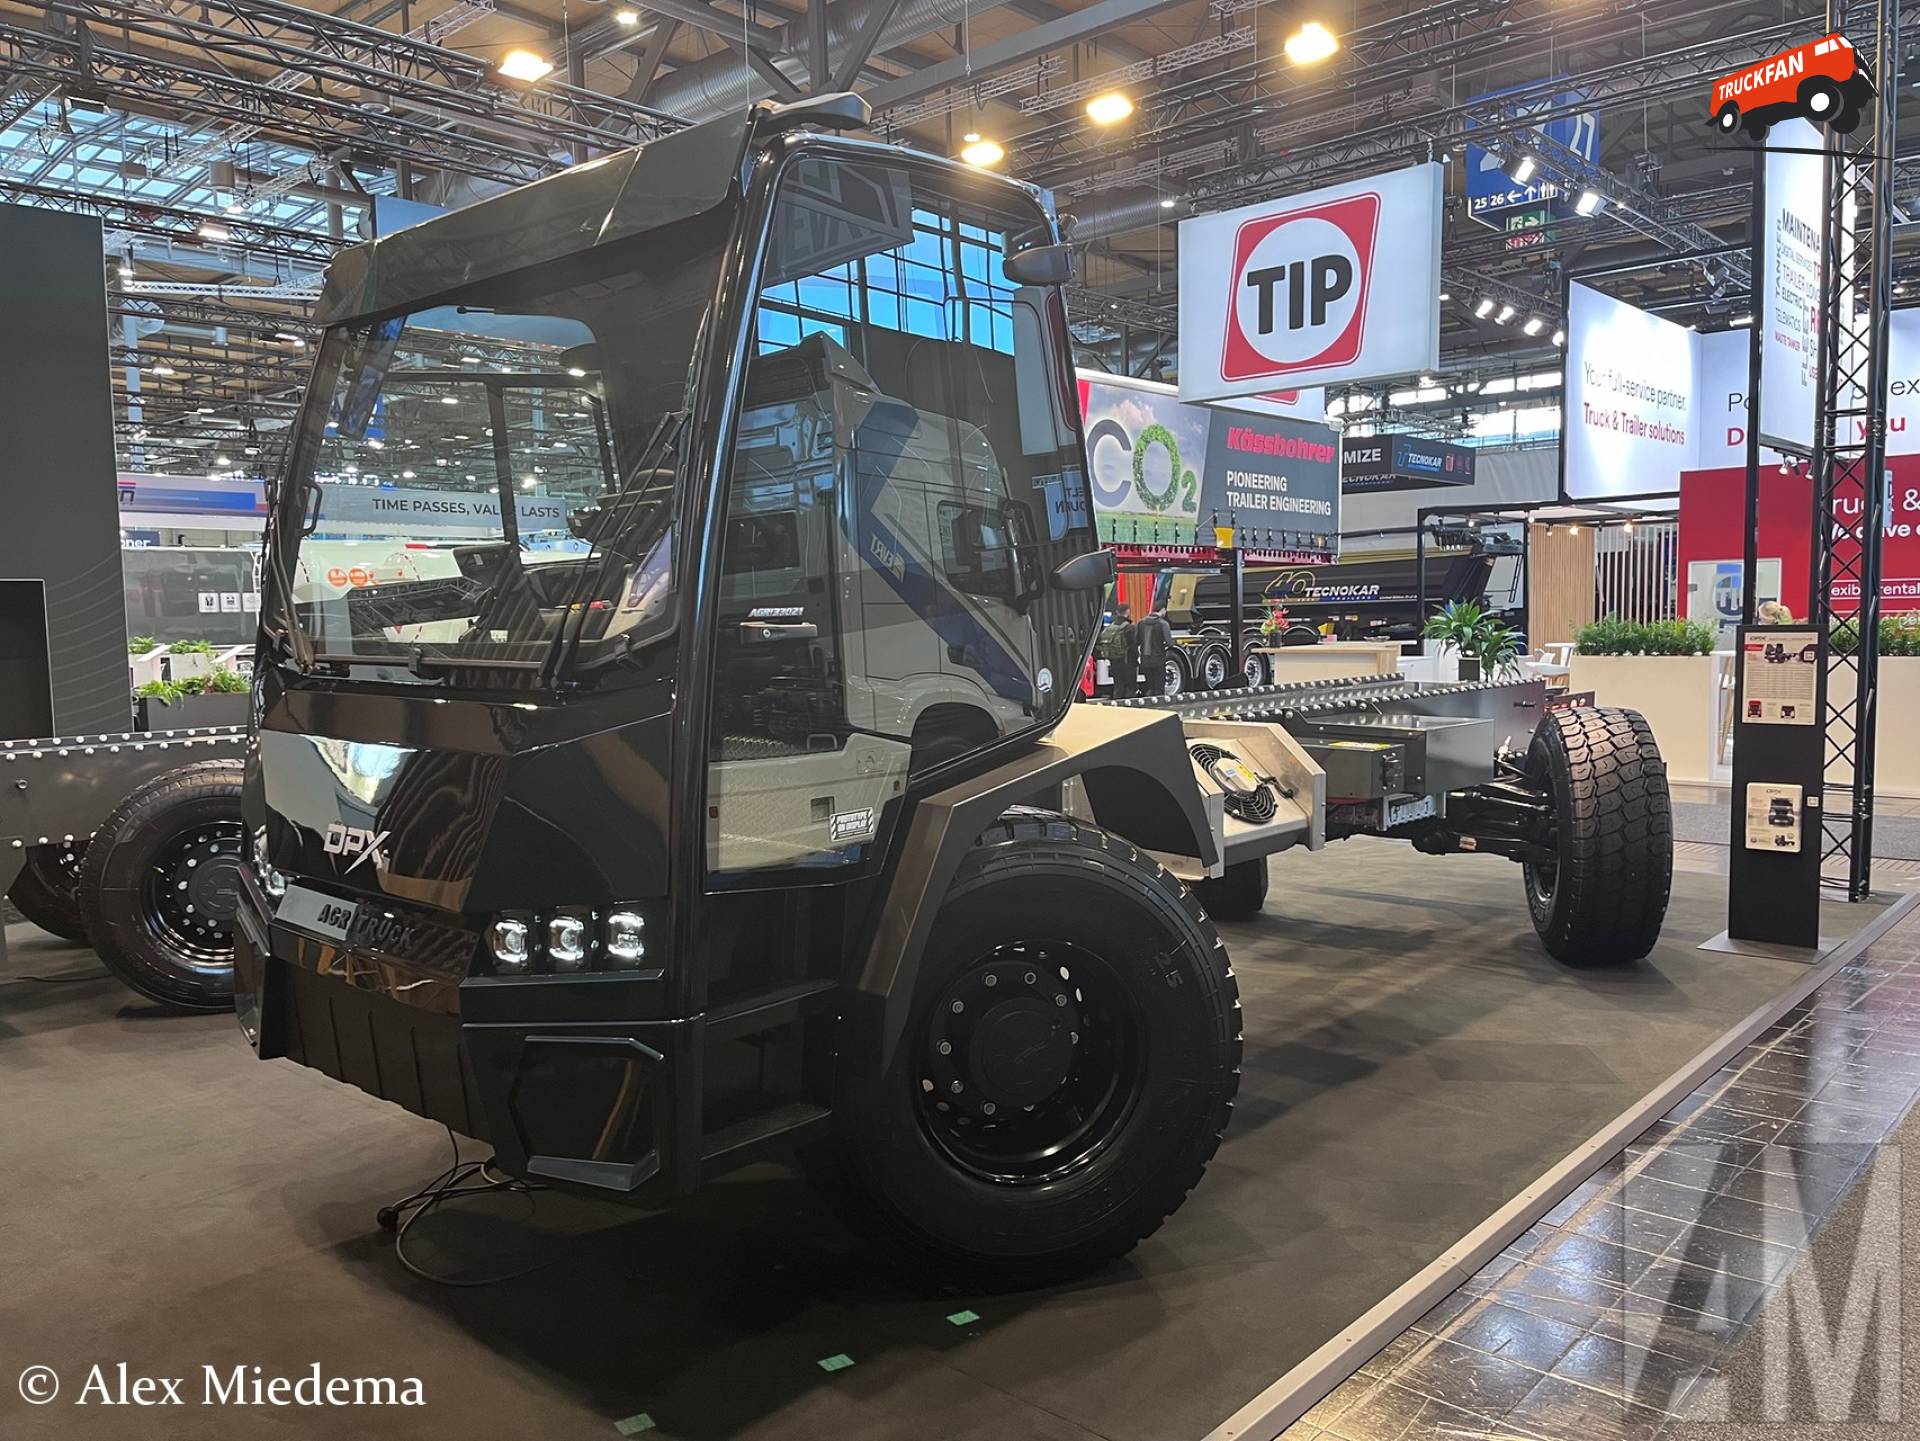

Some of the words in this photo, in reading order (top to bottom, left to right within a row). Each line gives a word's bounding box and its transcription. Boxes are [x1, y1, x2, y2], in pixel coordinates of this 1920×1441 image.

[1474, 198, 1487, 210] 25
[1490, 193, 1504, 206] 26
[1782, 207, 1820, 252] MAINTENA
[1247, 254, 1353, 335] TIP
[1584, 402, 1610, 429] Truck
[1612, 410, 1619, 430] &
[1621, 411, 1647, 438] Trailer
[1649, 420, 1685, 445] solutions
[1856, 416, 1906, 441] yu
[1226, 425, 1336, 464] Kässbohrer
[1343, 448, 1382, 464] MIZE
[1407, 453, 1442, 467] TECNOKAR
[1226, 470, 1287, 492] PIONEERING
[372, 498, 409, 511] TIME
[413, 500, 469, 516] PASSES,
[474, 504, 500, 516] VAL
[521, 506, 560, 518] LASTS
[1226, 491, 1268, 510] TRAILER
[1269, 495, 1331, 516] ENGINEERING
[1304, 585, 1380, 598] TECNOKAR
[323, 823, 391, 876] OPX
